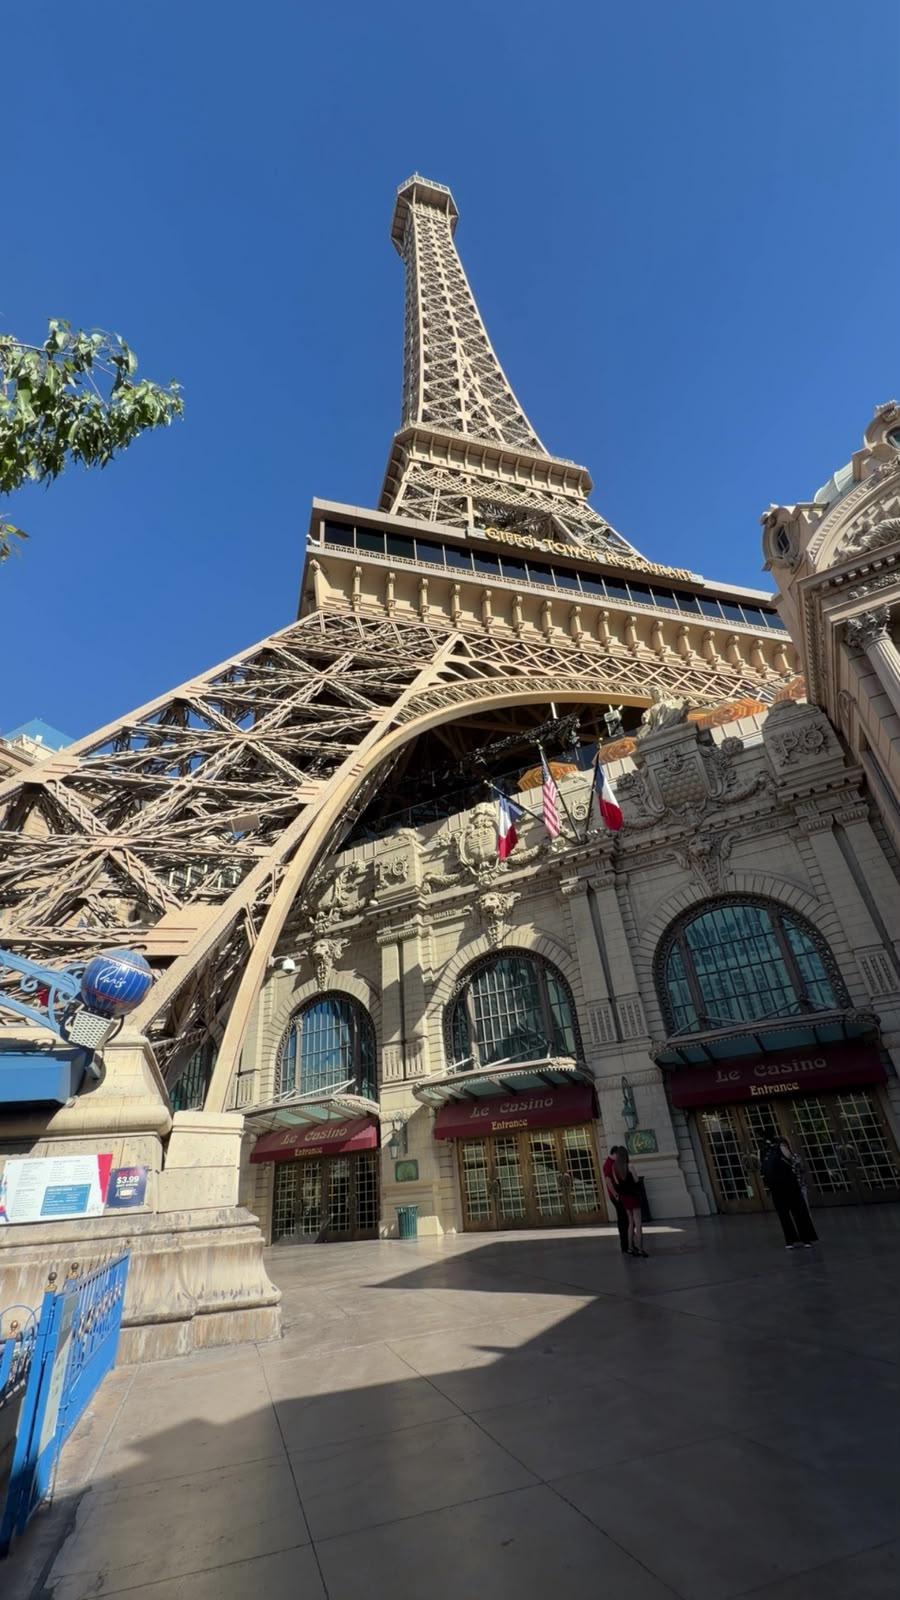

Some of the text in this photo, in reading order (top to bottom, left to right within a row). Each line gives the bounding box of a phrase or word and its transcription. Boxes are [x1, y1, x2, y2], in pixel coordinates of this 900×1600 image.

[485, 526, 692, 582] EIFFEL TOWER RESTAURANT
[95, 965, 127, 989] Paris
[715, 1057, 827, 1083] Le Casino
[750, 1081, 800, 1096] Entrance
[469, 1097, 554, 1119] Le Casino
[491, 1117, 529, 1131] Entrance
[280, 1127, 348, 1145] Le Casino
[294, 1146, 323, 1157] Entrance
[116, 1175, 140, 1185] $3.99
